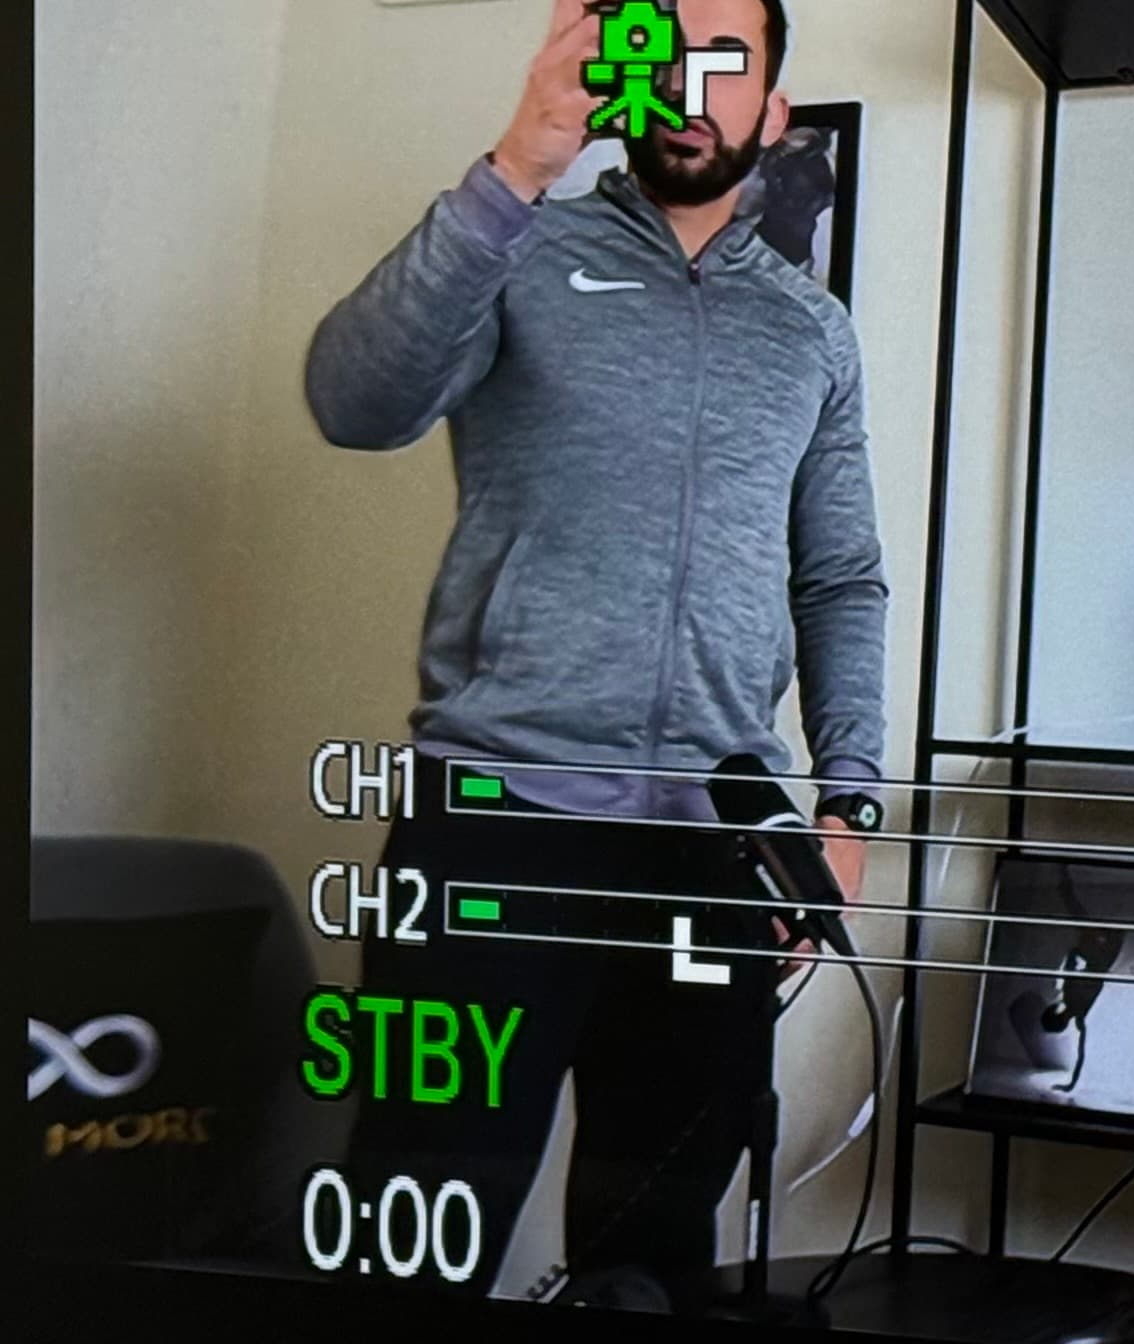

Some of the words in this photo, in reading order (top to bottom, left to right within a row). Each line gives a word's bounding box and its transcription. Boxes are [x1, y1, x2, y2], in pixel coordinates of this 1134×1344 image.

[311, 742, 417, 819] CH1
[311, 863, 428, 943] CH2
[302, 993, 524, 1108] STBY
[303, 1169, 481, 1281] 0:00
